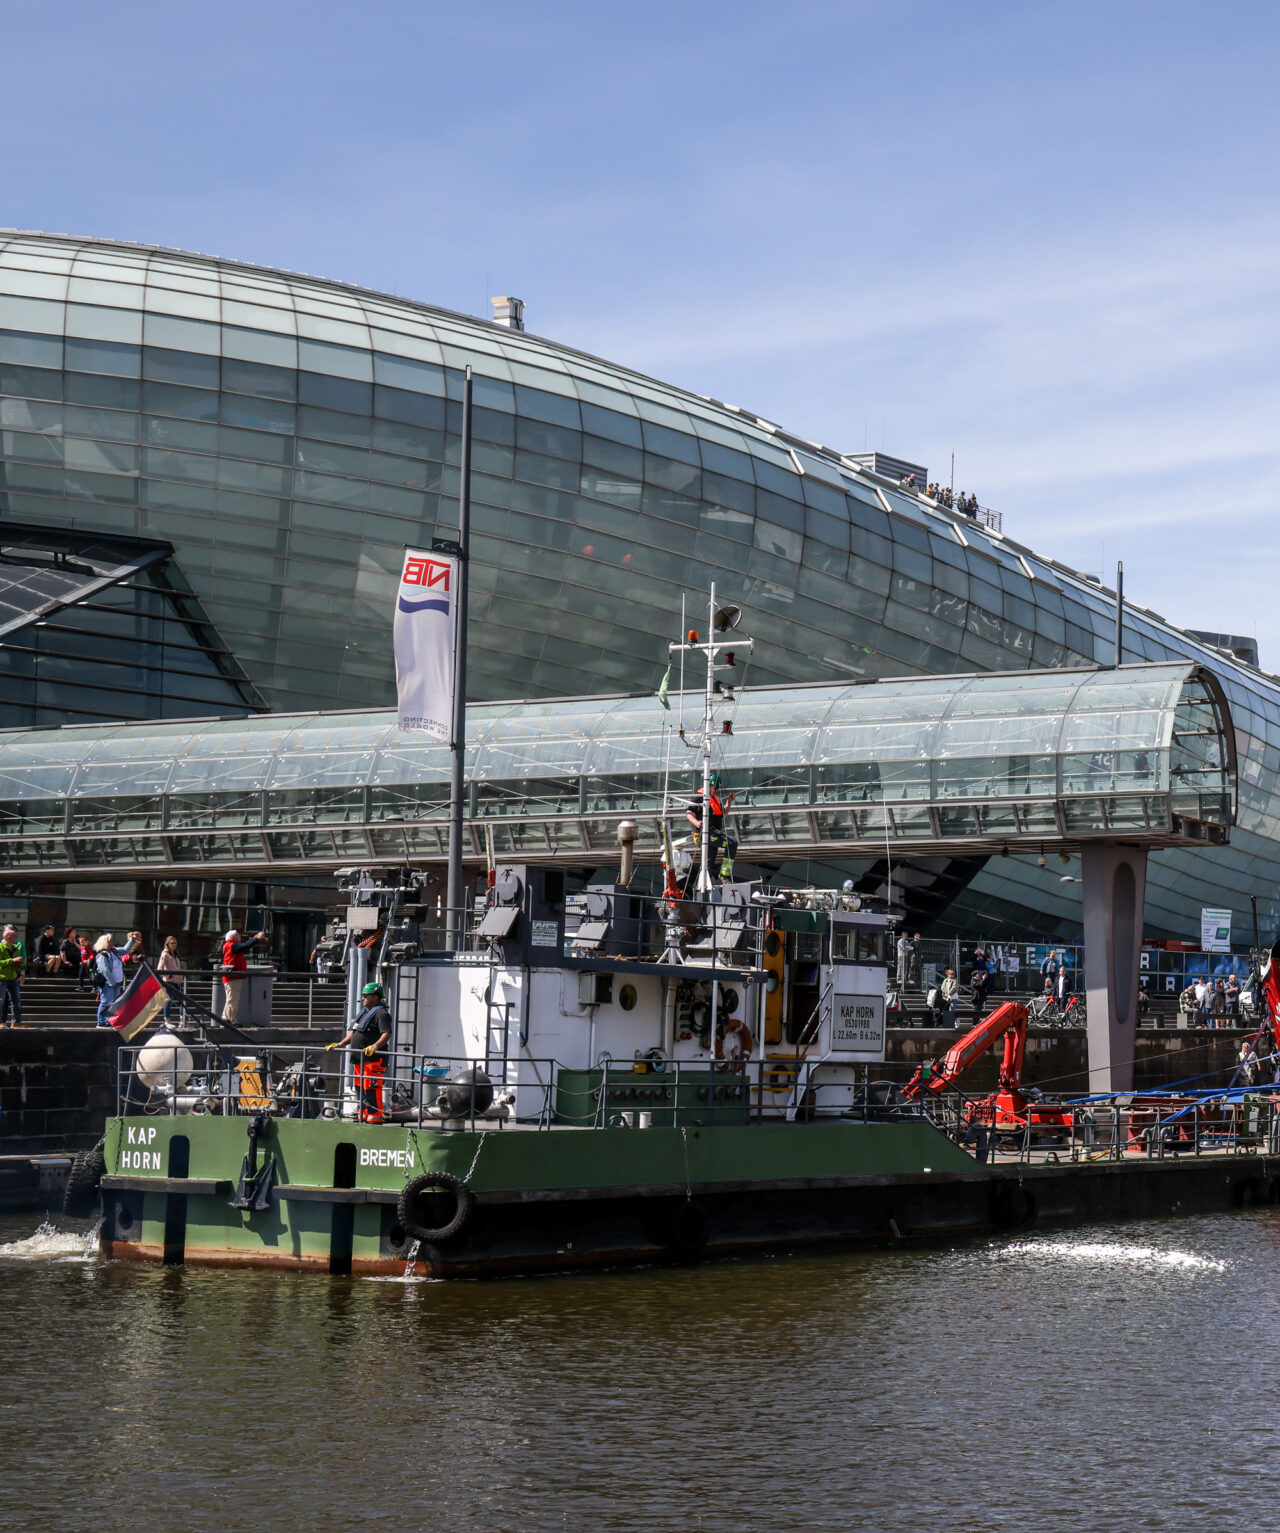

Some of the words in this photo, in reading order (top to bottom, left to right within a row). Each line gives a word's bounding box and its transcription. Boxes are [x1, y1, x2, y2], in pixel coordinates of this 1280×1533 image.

[841, 1006, 854, 1018] KAP
[861, 1006, 874, 1018] HORN
[128, 1126, 157, 1145] KAP
[121, 1150, 161, 1170] HORN
[360, 1148, 415, 1168] BREMEN
